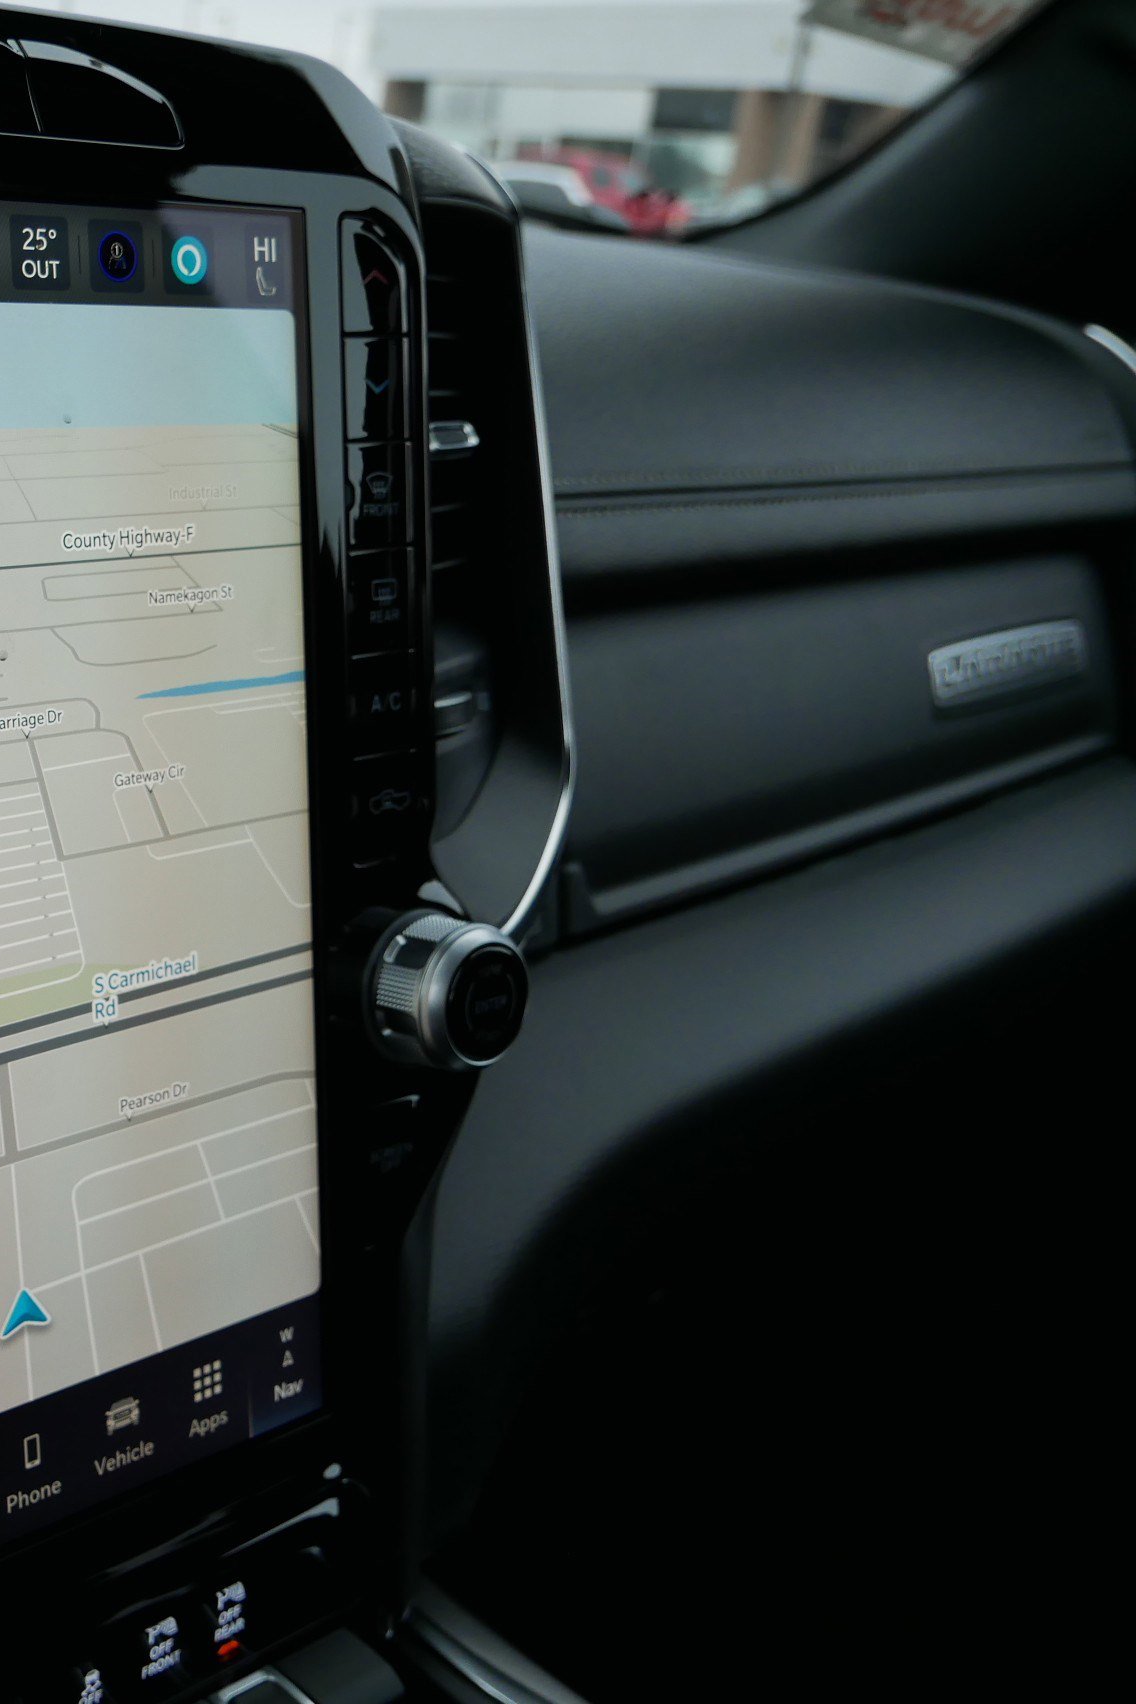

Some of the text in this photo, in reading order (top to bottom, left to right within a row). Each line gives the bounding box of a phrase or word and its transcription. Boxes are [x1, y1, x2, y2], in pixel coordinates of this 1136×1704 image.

[21, 226, 58, 252] 25°
[253, 236, 277, 264] HI
[21, 260, 60, 281] OUT
[169, 485, 237, 499] Industrial St
[62, 526, 195, 550] County Highway-F
[148, 586, 233, 606] Namekagon St
[48, 709, 63, 723] Dr
[114, 765, 185, 788] Gateway Cir
[94, 955, 196, 993] S Carmichael
[95, 999, 116, 1019] Rd
[120, 1083, 187, 1112] Pearson Dr
[279, 1326, 295, 1342] W
[273, 1378, 304, 1403] Nav
[189, 1409, 229, 1438] Apps
[94, 1438, 155, 1476] Vehicle
[6, 1479, 63, 1514] Phone
[218, 1604, 243, 1625] OFF
[213, 1617, 245, 1643] REAR
[149, 1638, 174, 1661] OFF
[141, 1649, 182, 1680] FRONT
